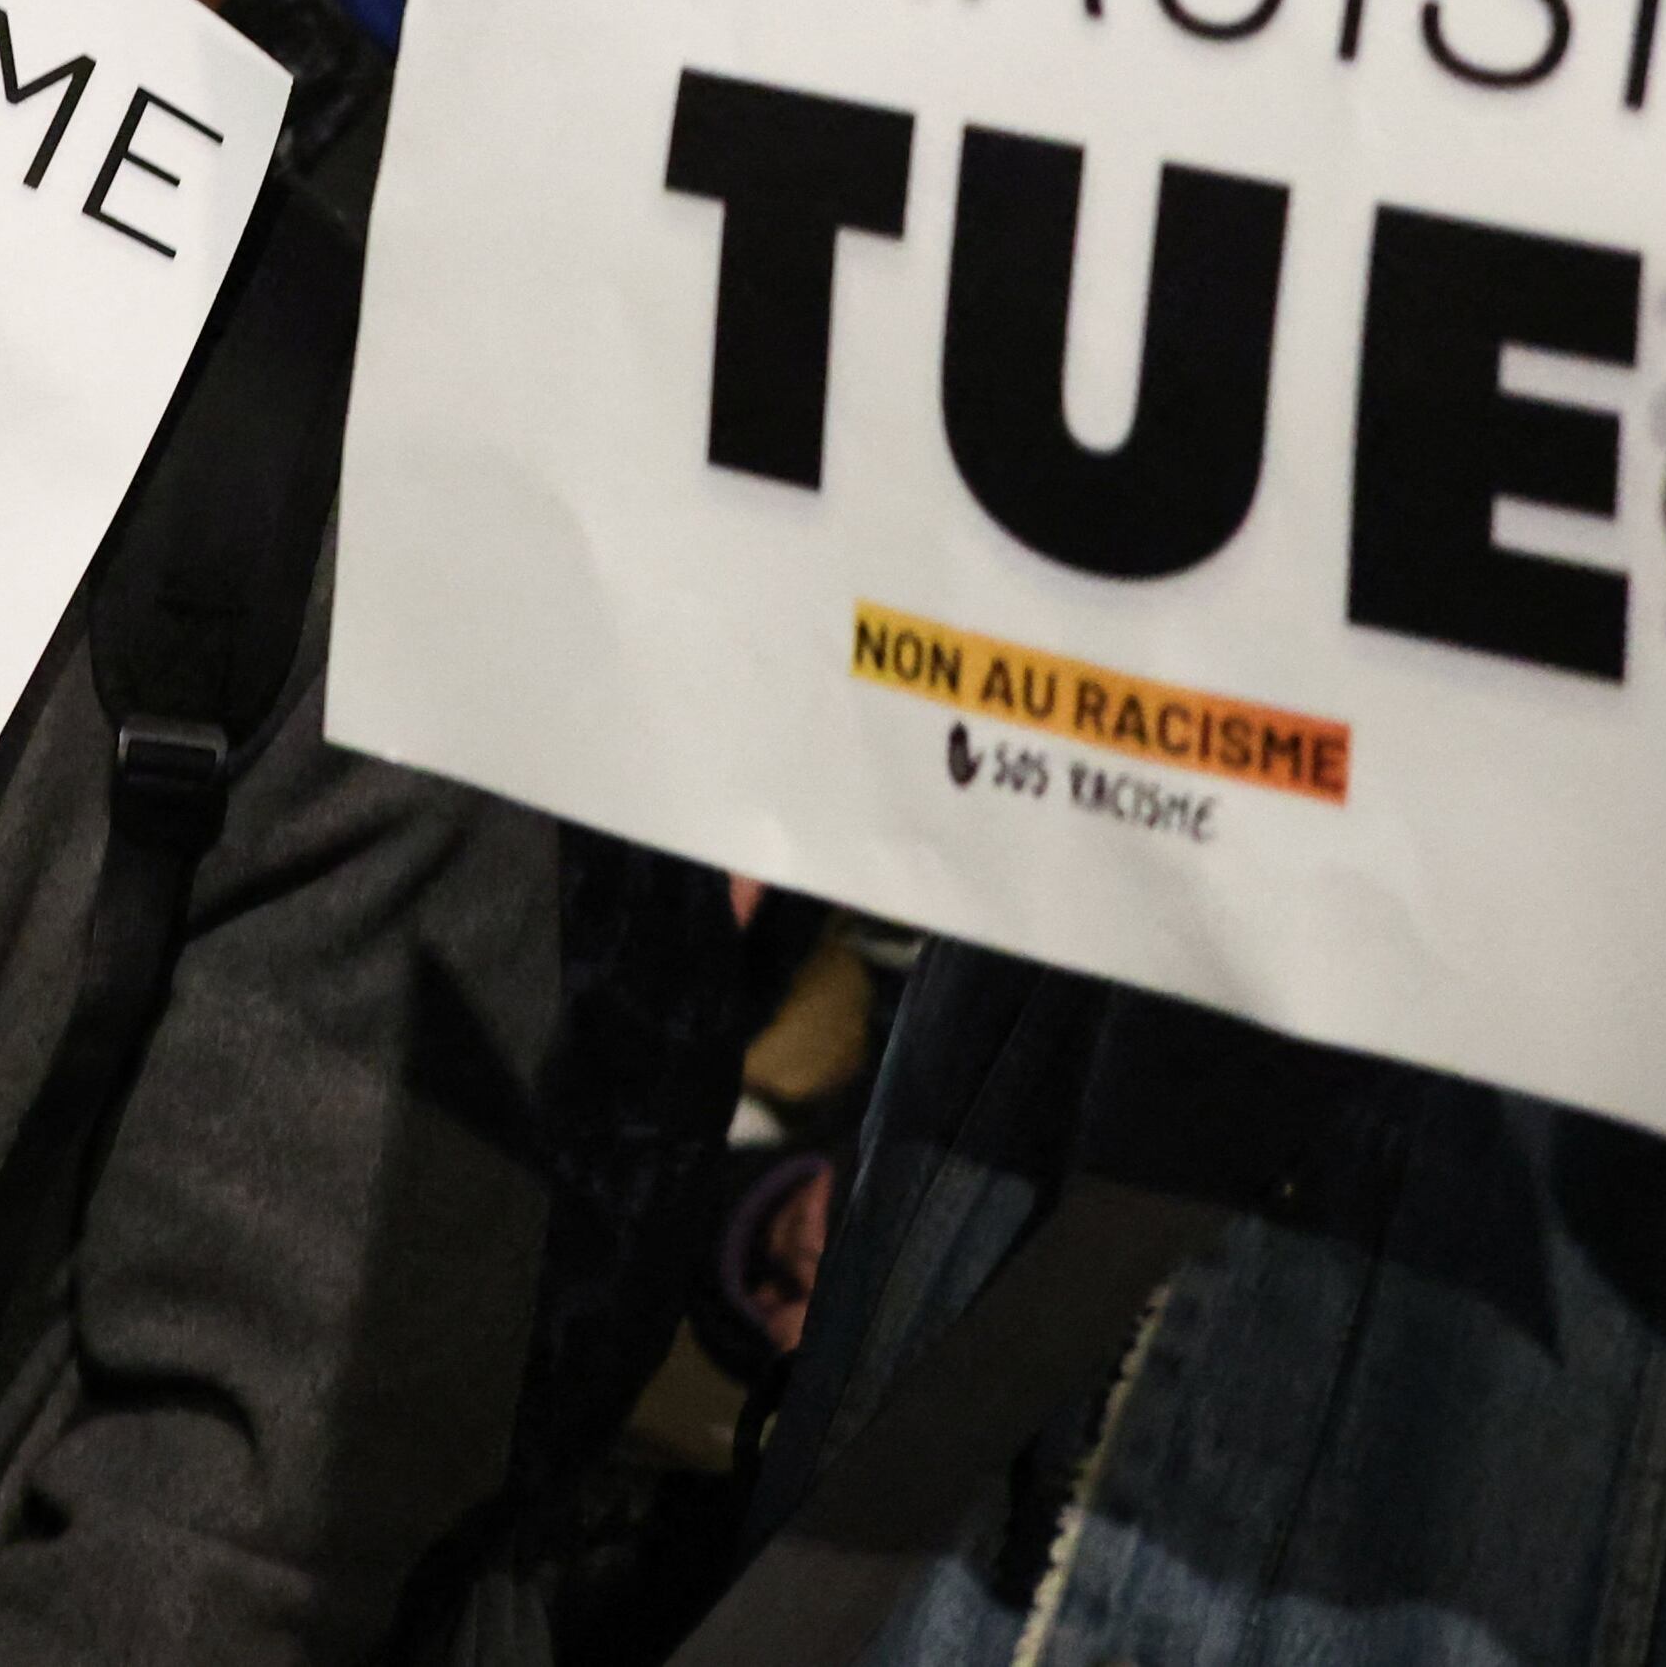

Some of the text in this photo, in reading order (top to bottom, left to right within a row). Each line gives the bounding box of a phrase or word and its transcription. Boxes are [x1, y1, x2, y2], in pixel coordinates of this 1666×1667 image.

[664, 68, 1644, 686] TUE
[854, 619, 1348, 793] NON AU RACISME
[992, 742, 1217, 842] SOS RACISME
